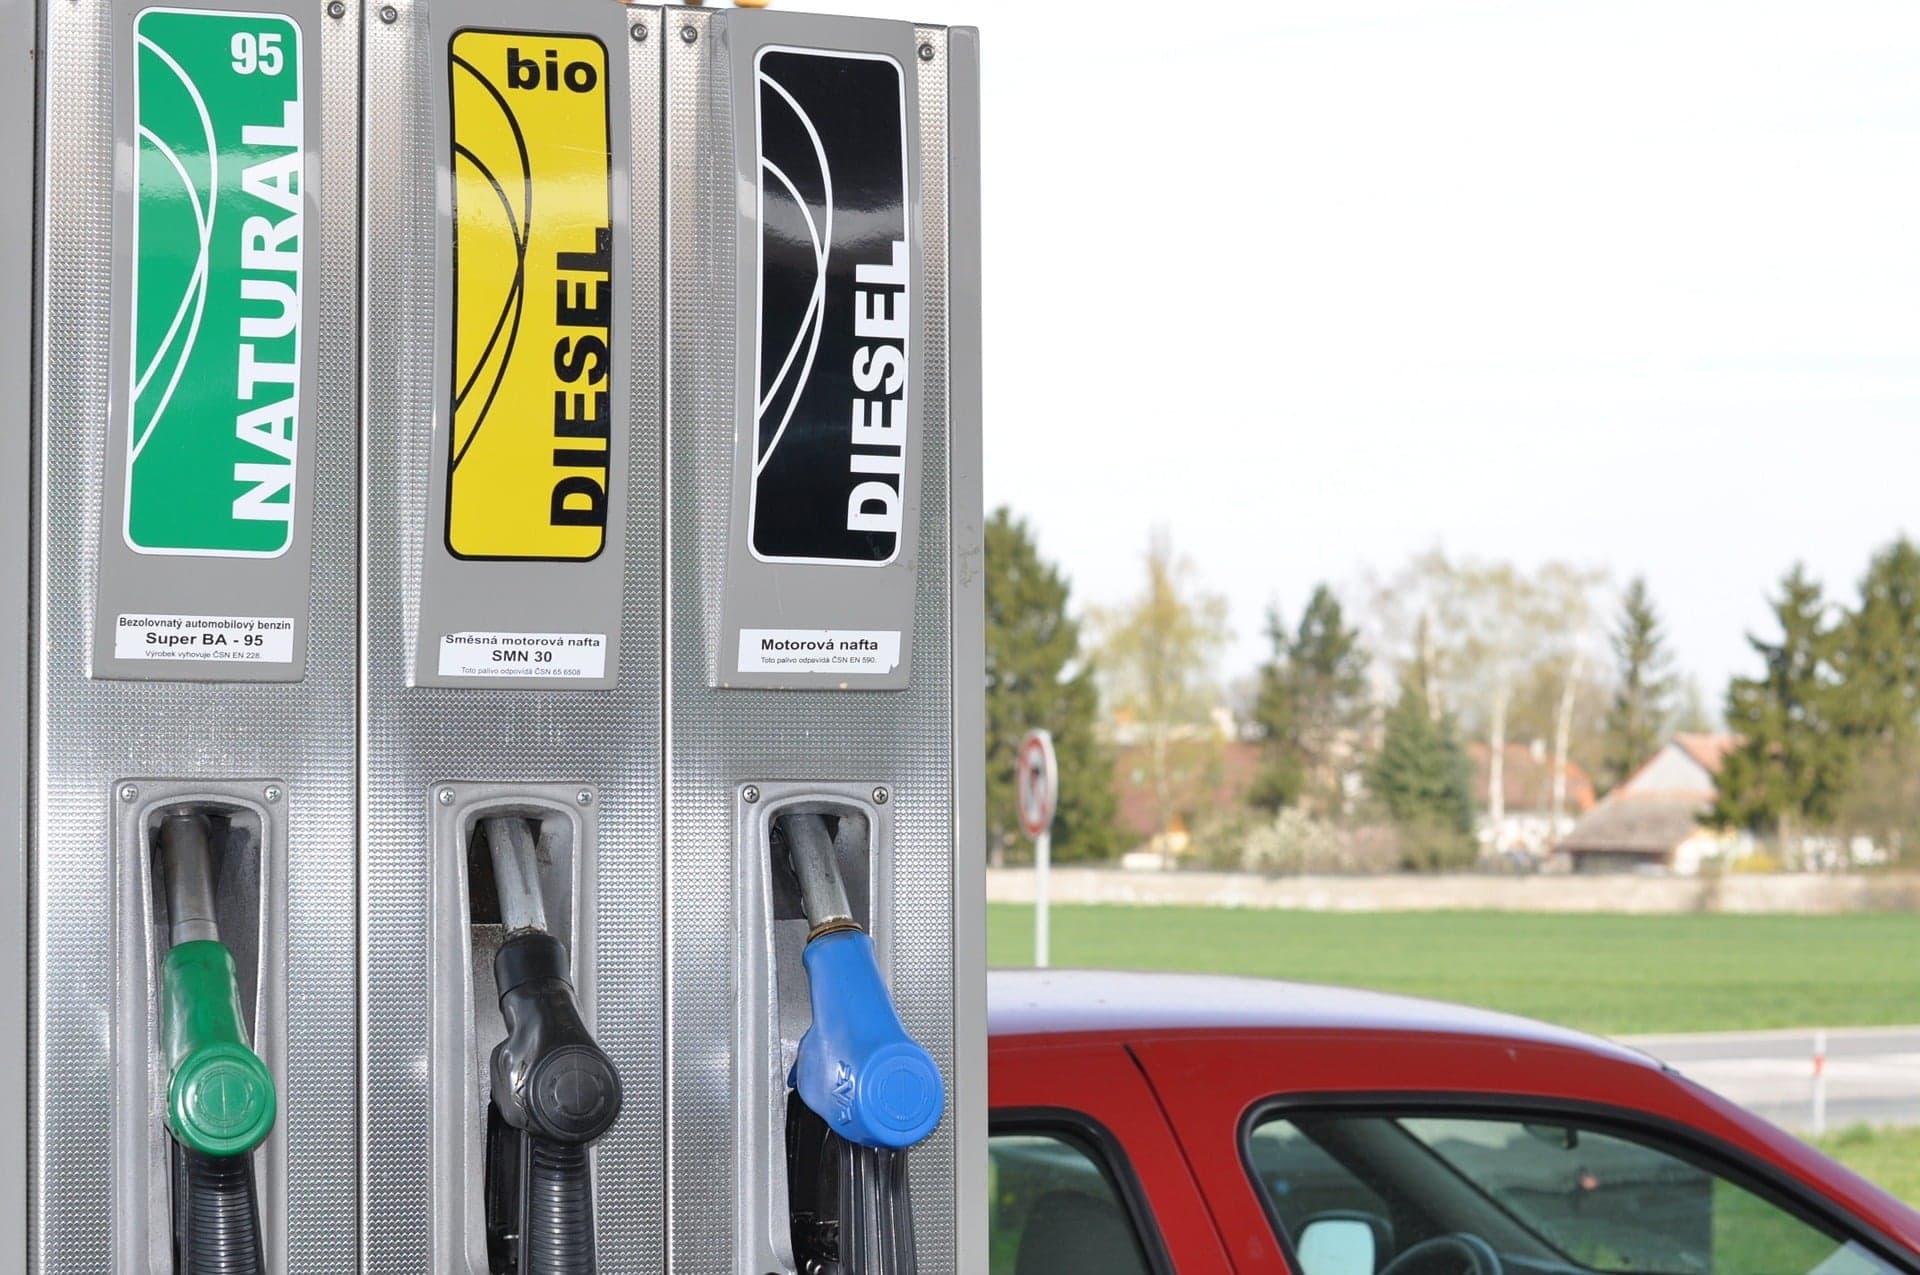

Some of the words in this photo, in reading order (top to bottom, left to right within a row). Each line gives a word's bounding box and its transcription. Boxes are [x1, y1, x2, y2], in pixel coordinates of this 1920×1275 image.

[231, 32, 284, 77] 95
[507, 47, 599, 93] bio
[231, 100, 306, 522] NATURAL
[550, 227, 611, 528] DIESEL
[846, 240, 909, 534] DIESEL
[119, 617, 182, 630] Bezolovnatý
[185, 620, 255, 631] automobilový
[257, 620, 291, 630] benzin
[145, 632, 198, 647] Super
[202, 633, 228, 646] BA
[243, 634, 264, 647] 95
[445, 634, 498, 645] Směsná
[501, 636, 564, 647] motorová
[567, 637, 600, 647] nafta
[761, 638, 834, 650] Motorová
[840, 638, 878, 650] nafta
[212, 650, 231, 659] ČSN
[232, 651, 244, 659] EN
[491, 649, 529, 662] SMN
[534, 650, 553, 663] 30
[761, 656, 776, 664] Toto
[831, 655, 848, 663] ČSN
[461, 666, 477, 674] Toto
[534, 667, 551, 675] ČSN
